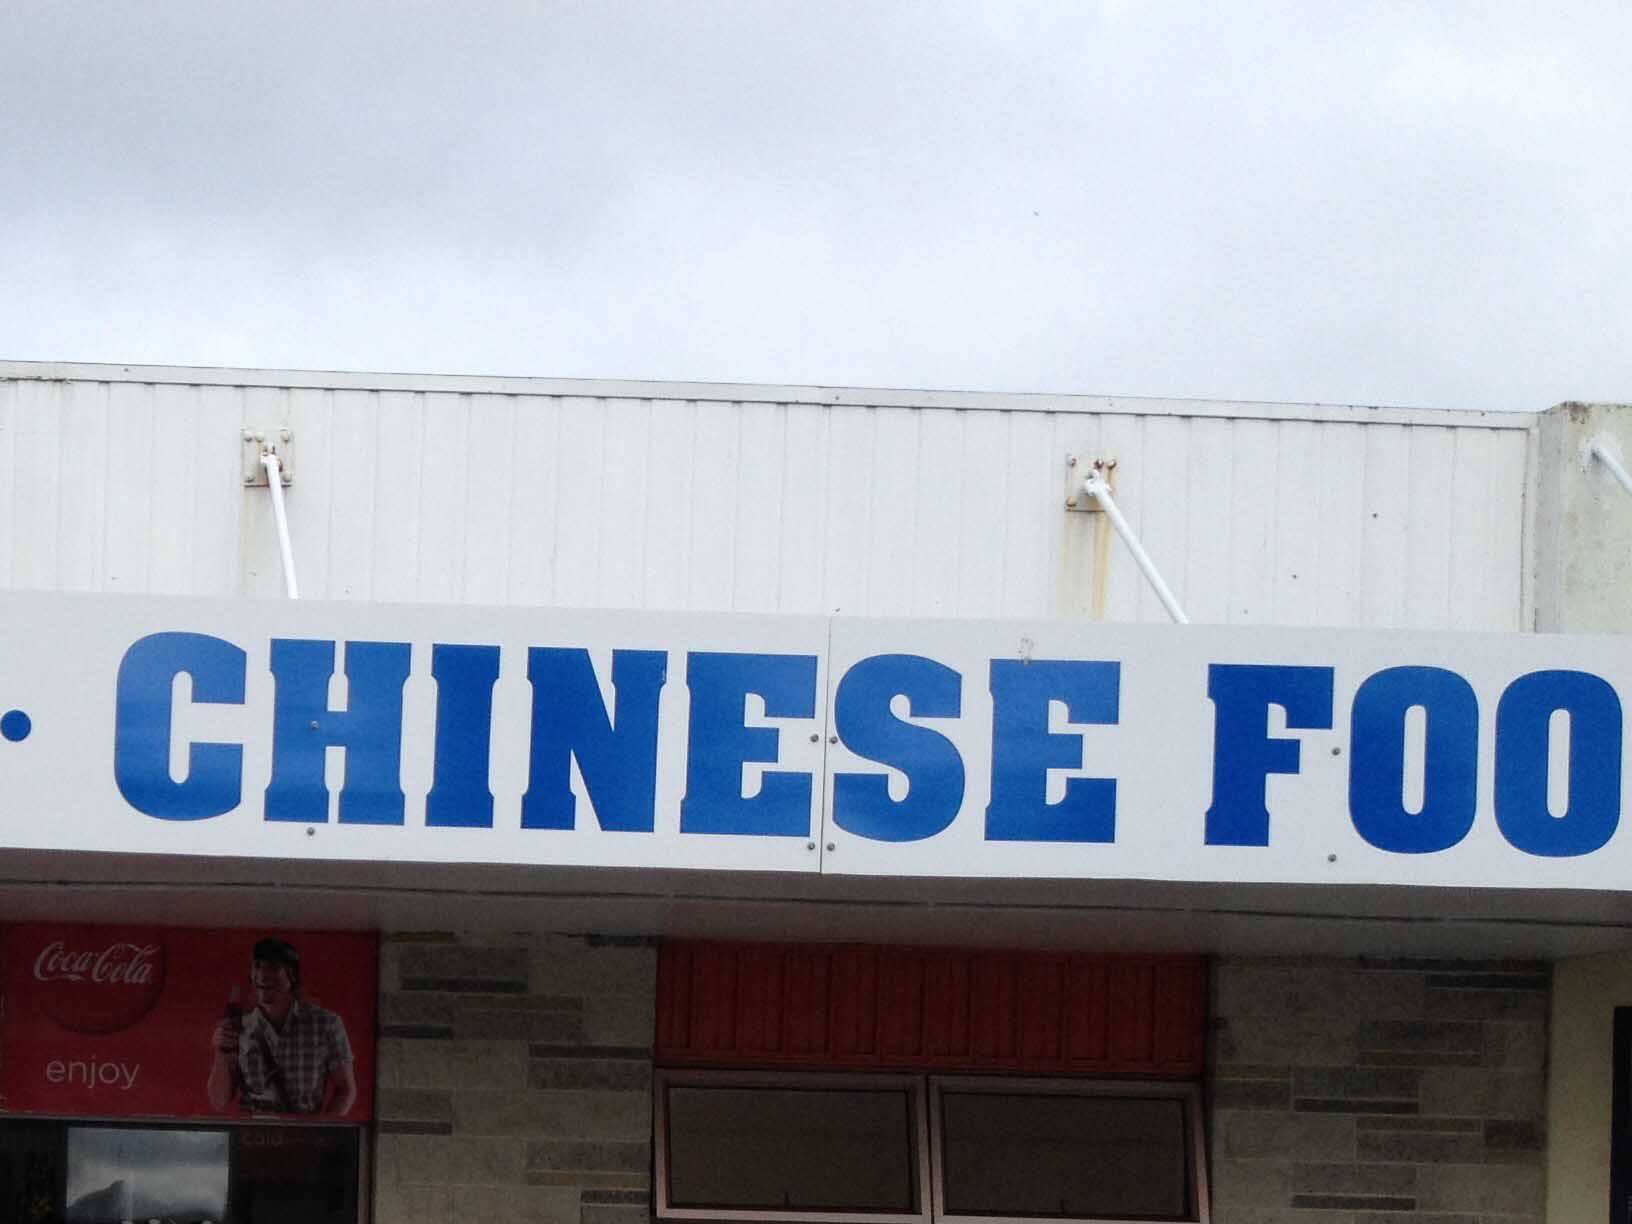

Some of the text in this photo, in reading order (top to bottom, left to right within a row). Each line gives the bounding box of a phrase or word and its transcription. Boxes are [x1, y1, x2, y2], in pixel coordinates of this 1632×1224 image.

[113, 631, 1121, 844] CHINESE
[33, 941, 160, 985] Coca-Cola
[46, 1056, 140, 1090] enjoy
